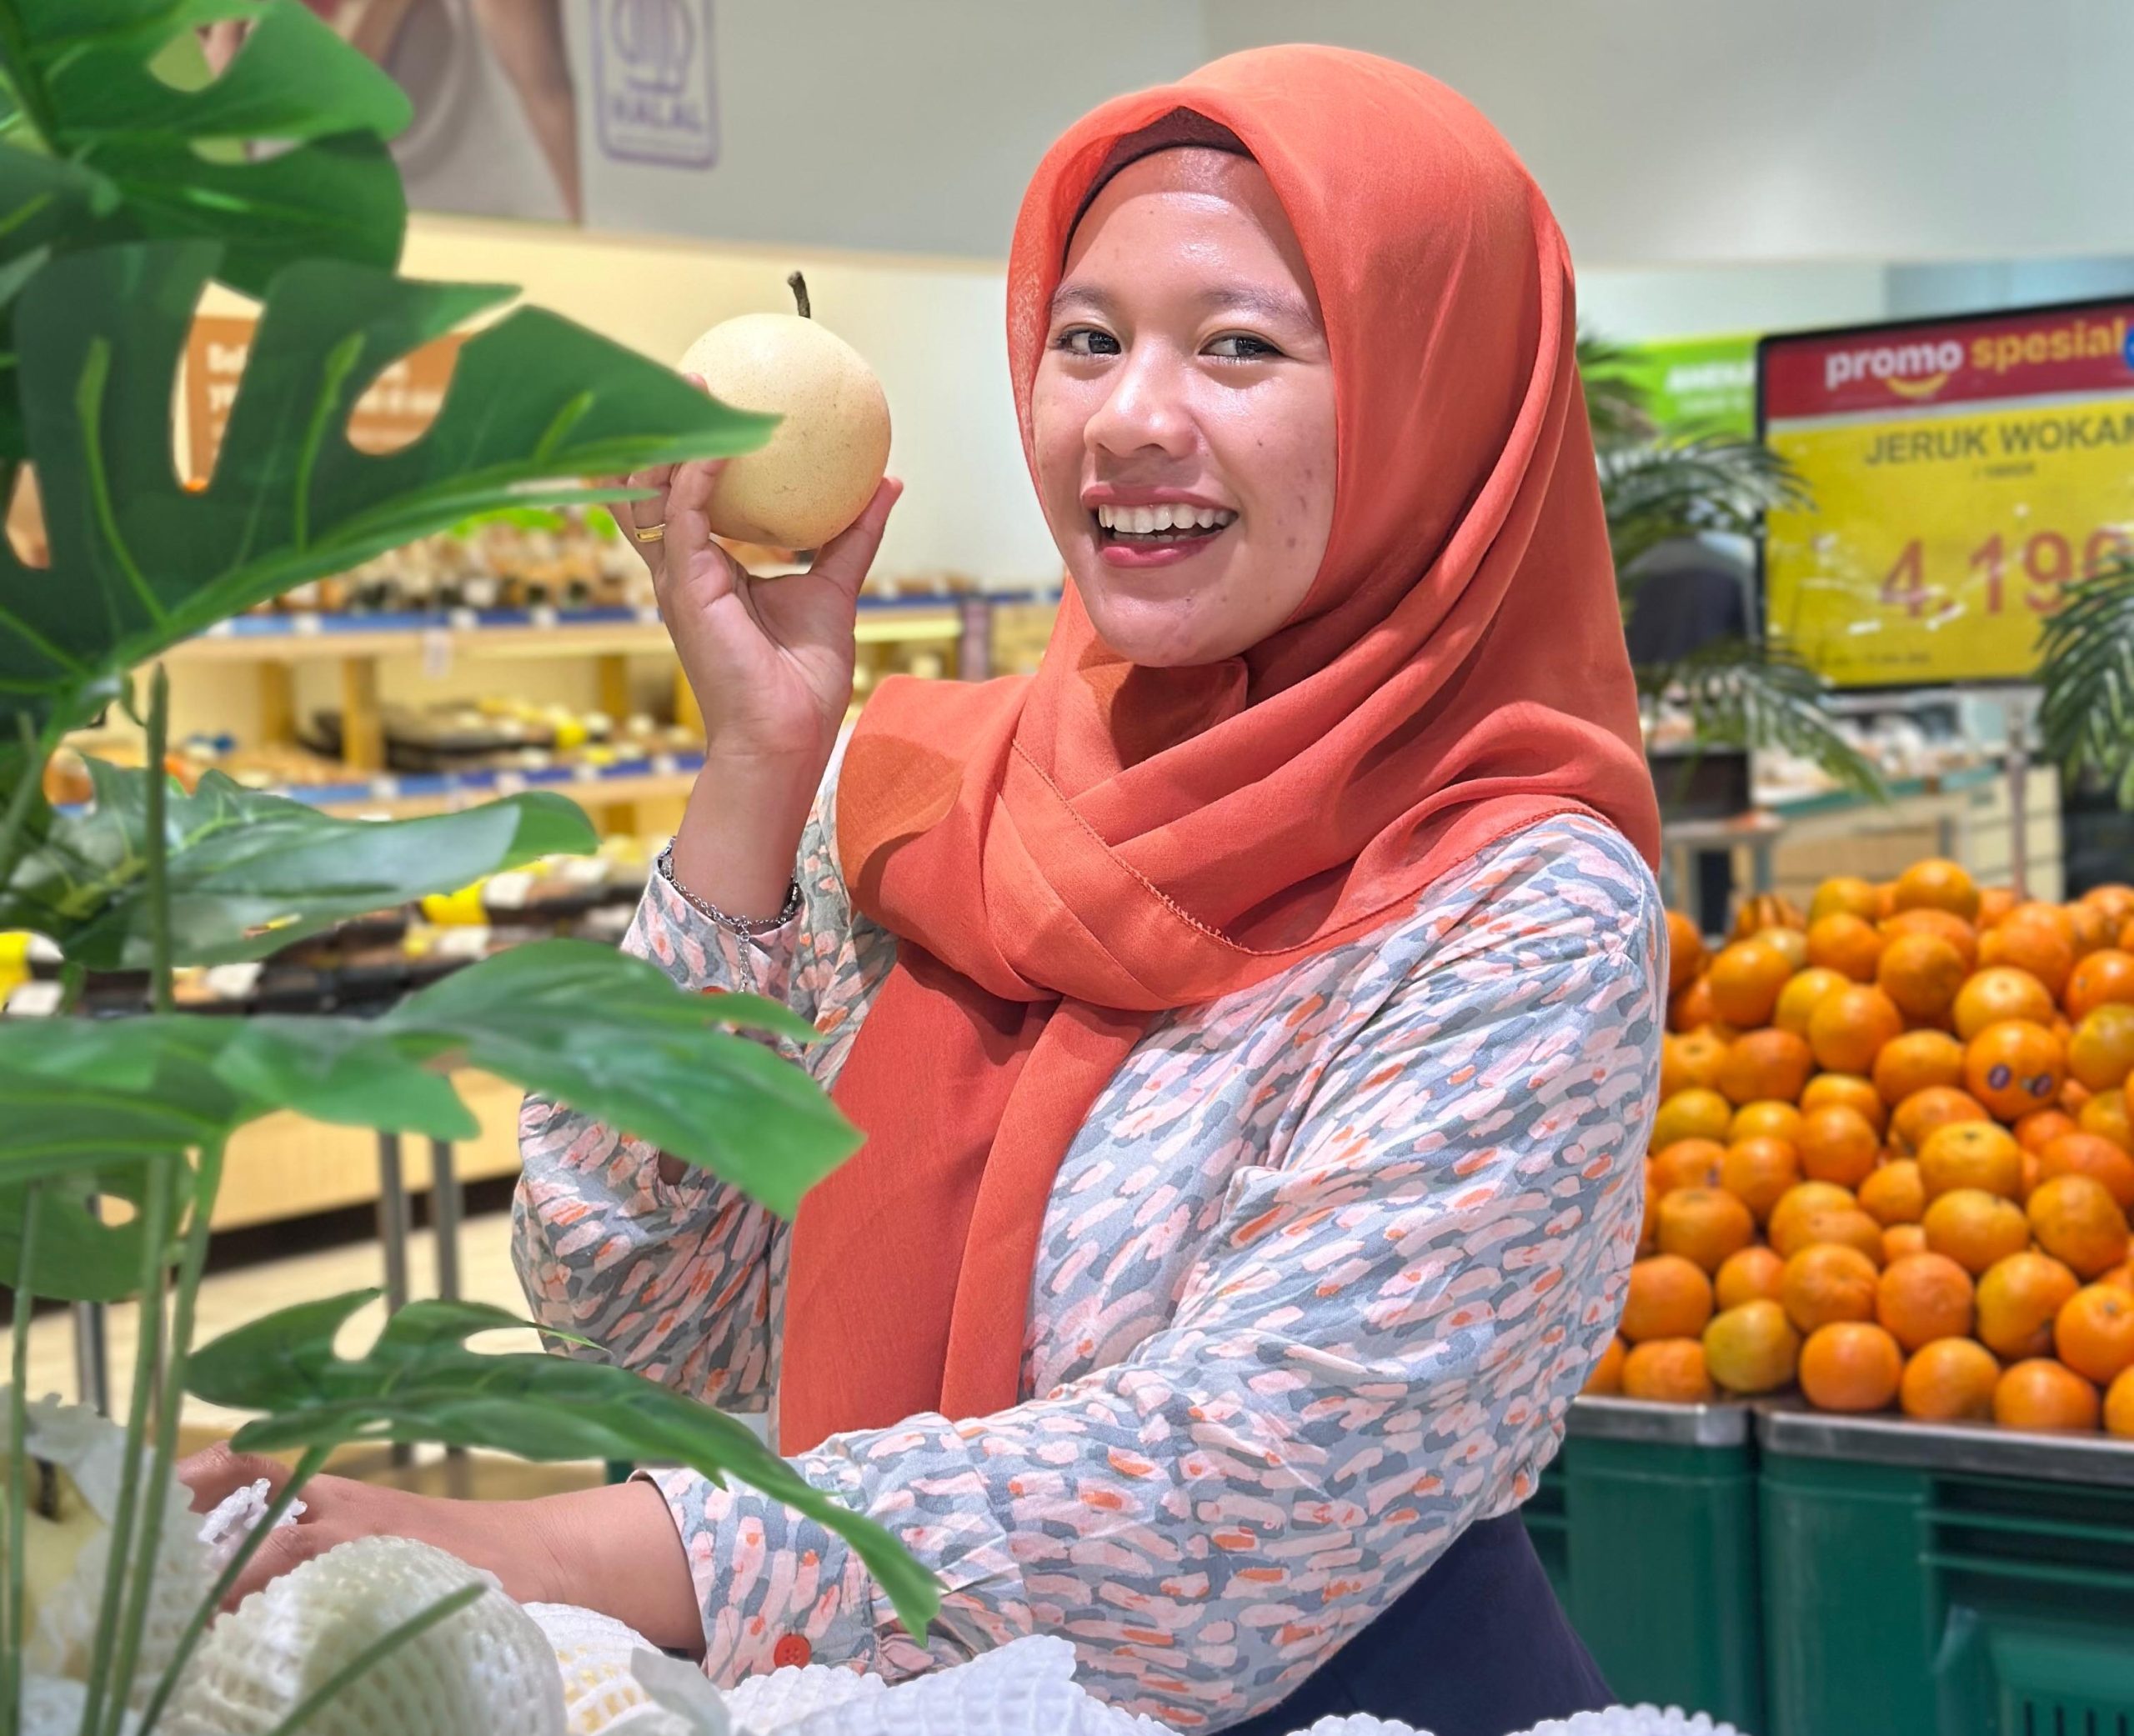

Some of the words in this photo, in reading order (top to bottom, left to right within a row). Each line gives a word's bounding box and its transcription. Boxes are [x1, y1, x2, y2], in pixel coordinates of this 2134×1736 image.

[1826, 341, 1963, 389] promo
[1971, 317, 2126, 373] spesial
[1865, 428, 1988, 466] JERUK
